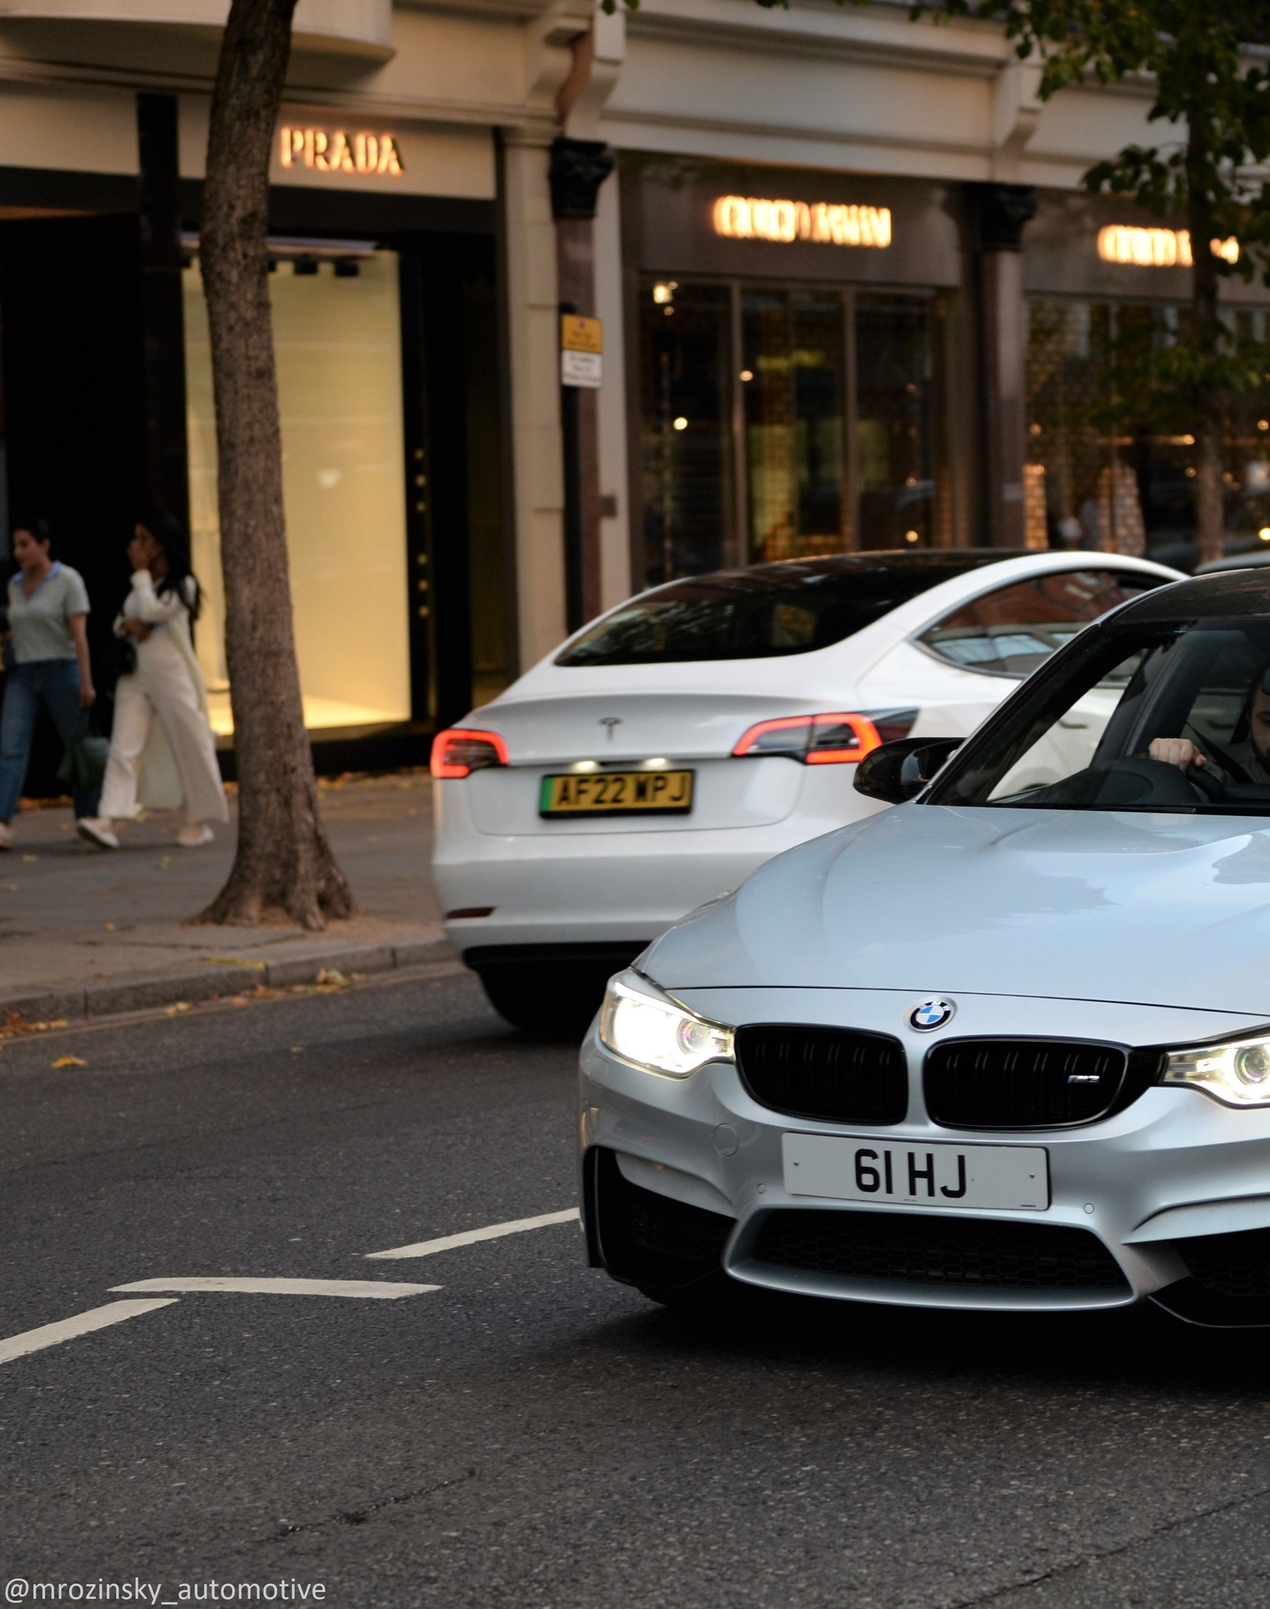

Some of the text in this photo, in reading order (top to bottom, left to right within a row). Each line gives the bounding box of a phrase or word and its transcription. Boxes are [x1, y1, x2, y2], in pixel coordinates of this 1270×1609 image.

[279, 127, 405, 177] PRADA
[555, 776, 627, 806] AF22
[854, 1148, 967, 1199] 61 HJ
